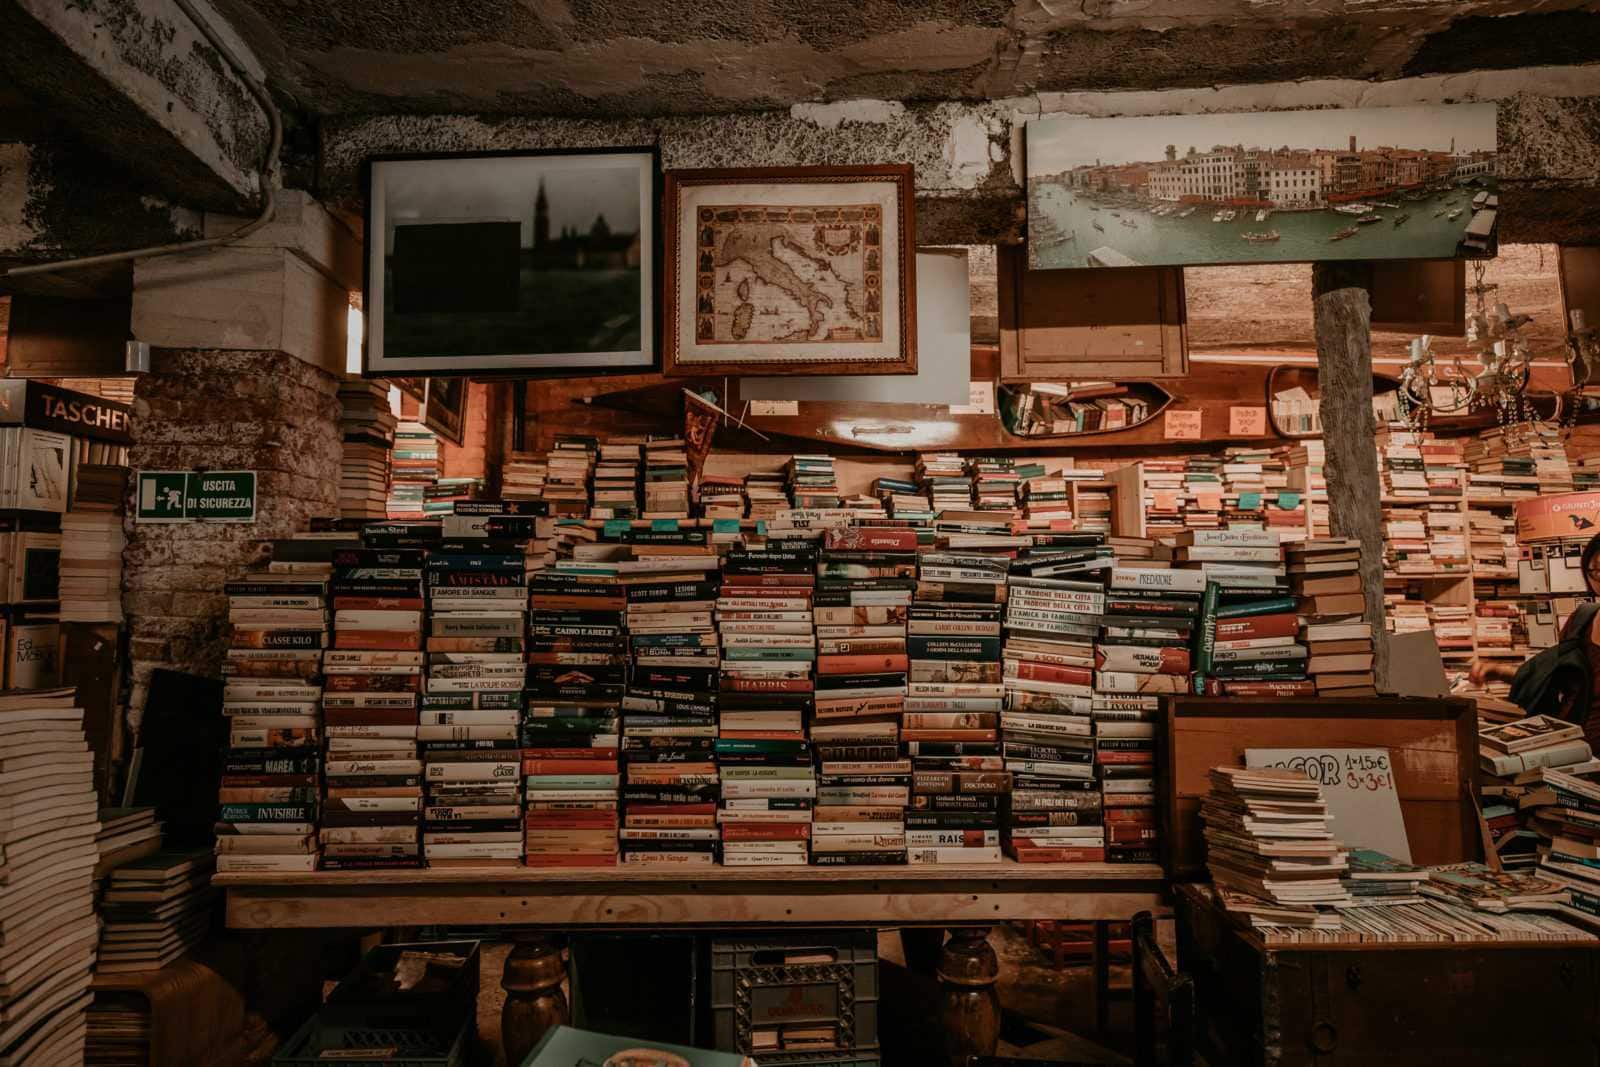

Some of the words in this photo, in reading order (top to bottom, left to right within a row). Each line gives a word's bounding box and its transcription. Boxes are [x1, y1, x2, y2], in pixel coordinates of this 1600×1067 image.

[203, 480, 235, 492] USCITA
[187, 498, 197, 508] DI
[200, 498, 251, 508] SICUREZZA
[448, 573, 510, 587] AMISTAD
[1139, 574, 1172, 586] PREDATORE
[437, 588, 461, 596] AMORE
[463, 588, 471, 596] DI
[472, 588, 497, 596] SANGUE
[555, 627, 580, 635] CAINO
[263, 635, 291, 645] CLASSE
[293, 635, 313, 645] KILO
[480, 681, 500, 689] VOLPE
[501, 681, 522, 689] ROSSA
[265, 759, 295, 773] MAREA
[1264, 755, 1341, 785] GOR
[1049, 812, 1078, 826] MIKO
[938, 834, 964, 843] RAIS
